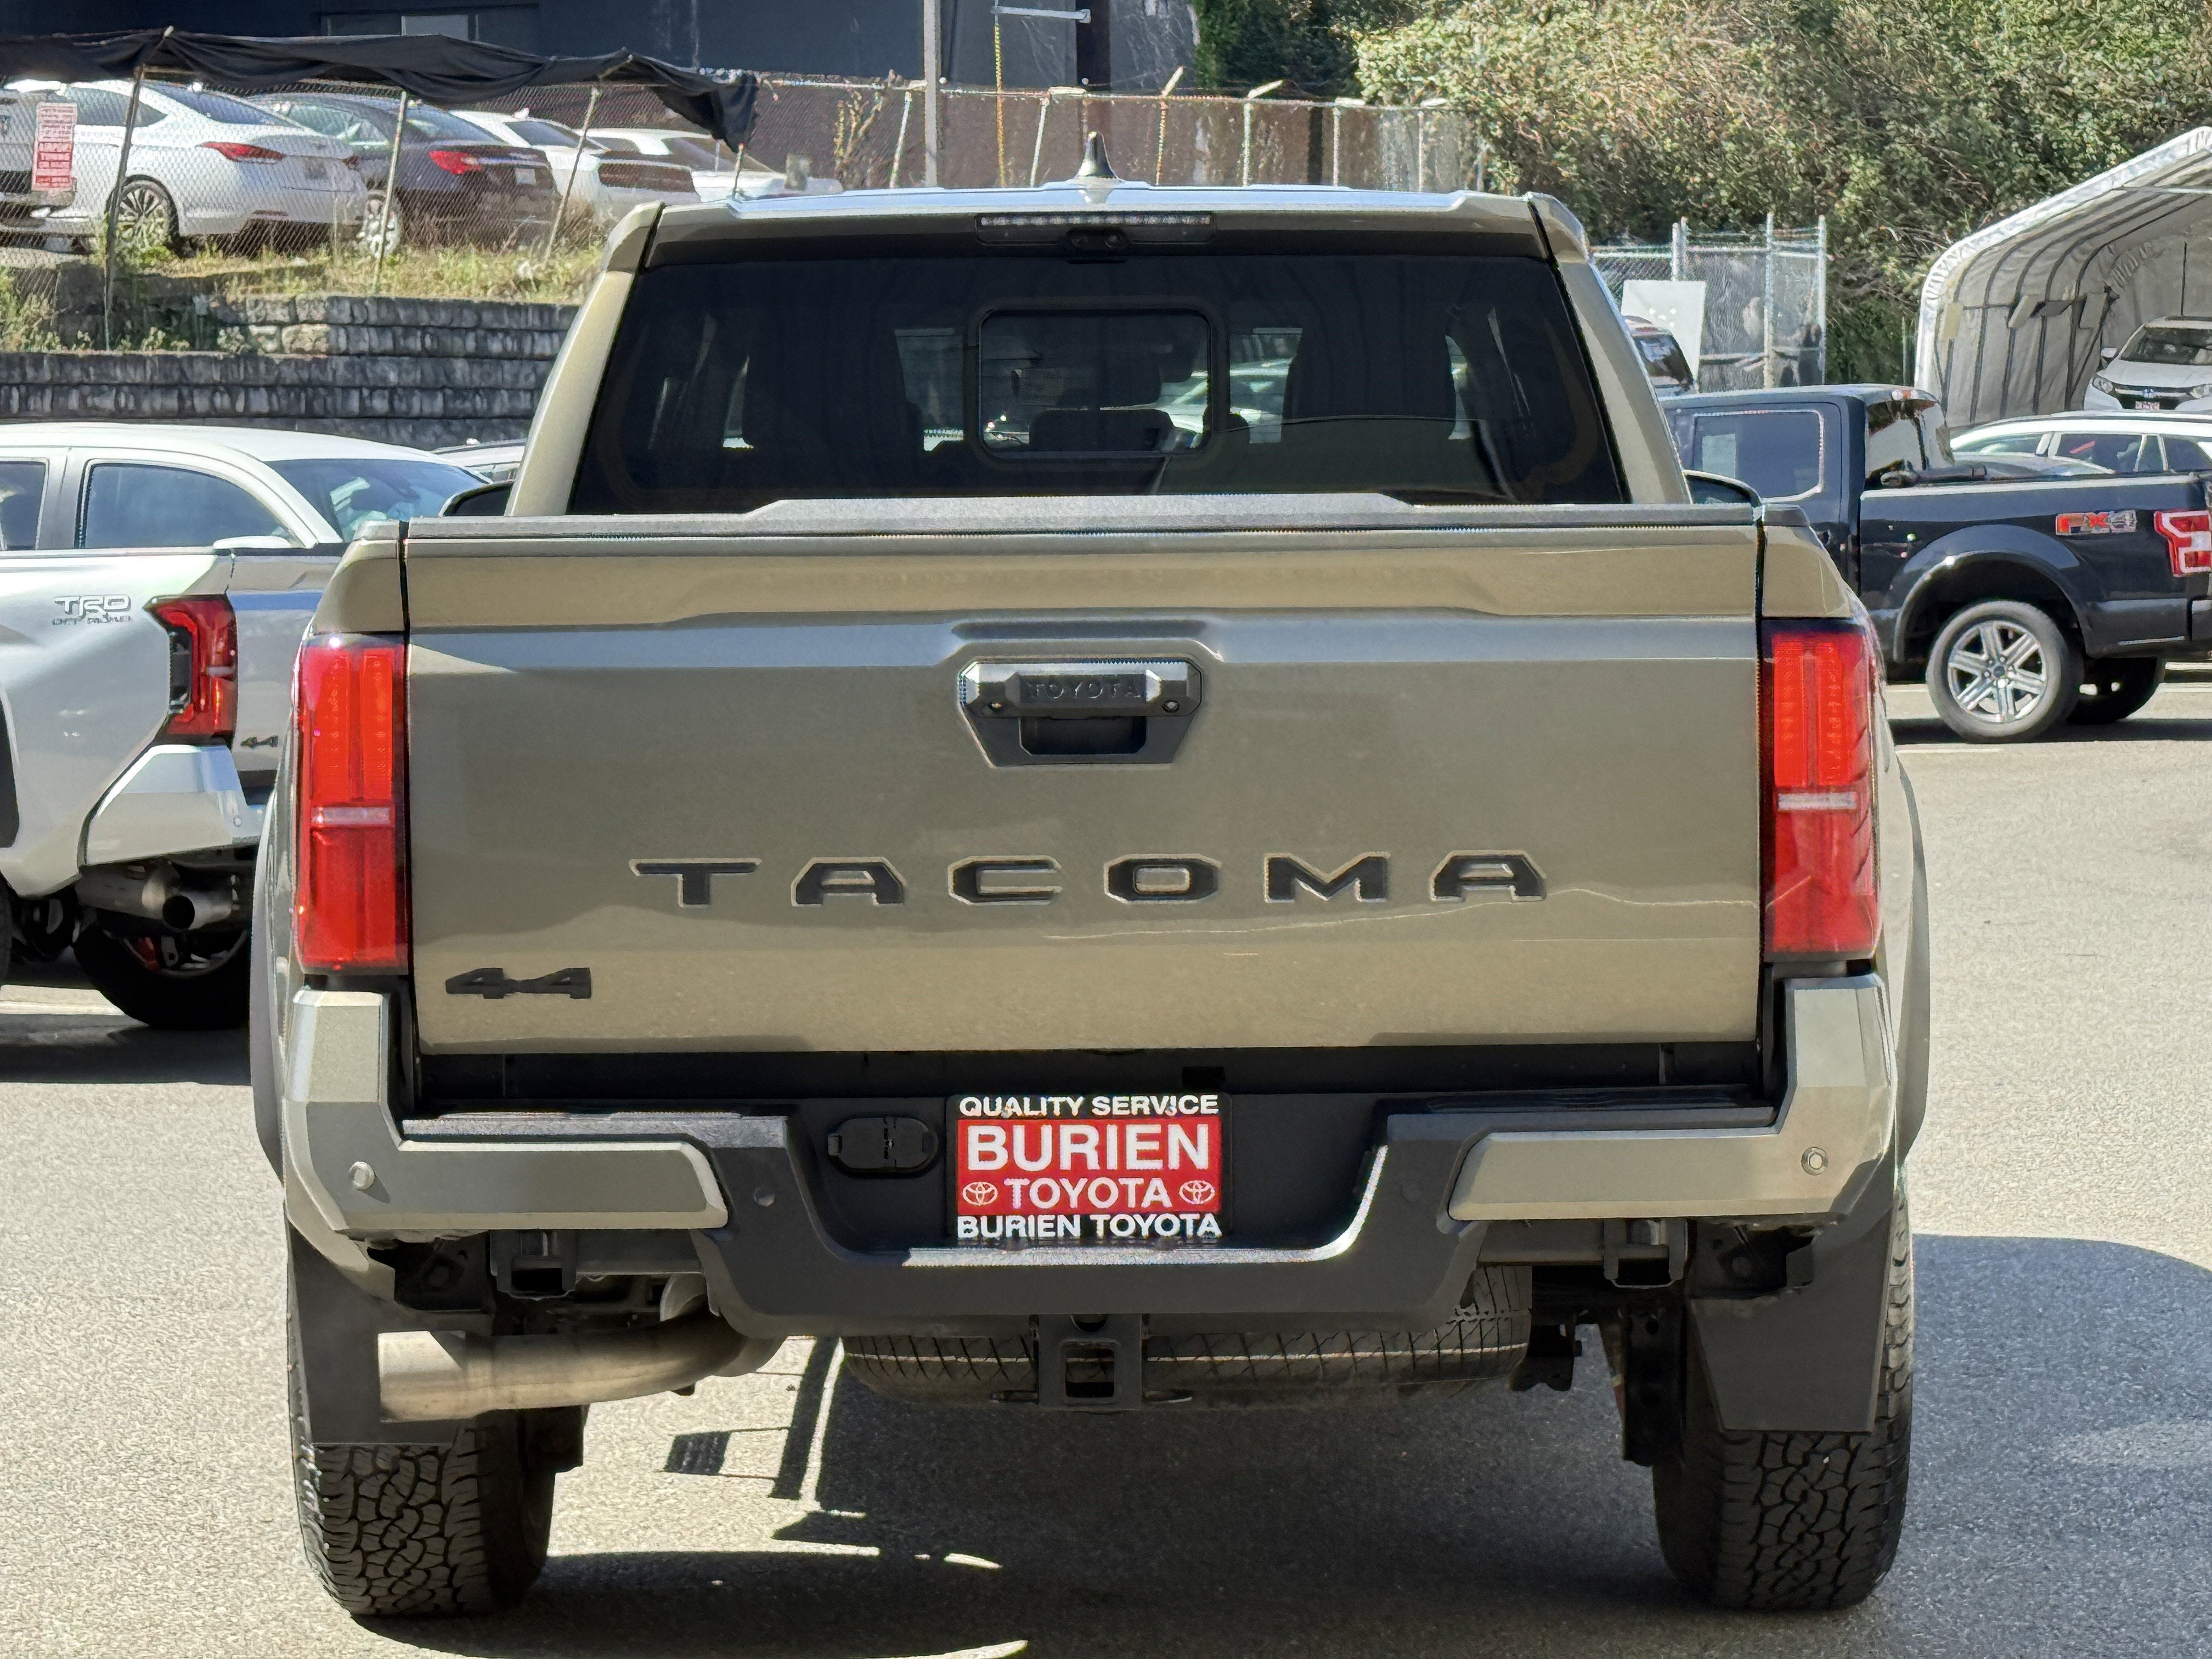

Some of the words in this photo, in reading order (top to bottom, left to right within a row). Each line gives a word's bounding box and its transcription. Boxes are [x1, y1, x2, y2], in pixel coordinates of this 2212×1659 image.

[54, 595, 131, 619] TRD
[1027, 681, 1142, 699] TOYOTA
[629, 850, 1547, 906] TACOMA
[959, 1096, 1084, 1117] QUALITY
[1091, 1094, 1219, 1116] SERVICE
[967, 1124, 1209, 1171] BURIEN
[1003, 1177, 1173, 1209] TOYOTA
[957, 1215, 1081, 1238] BURIEN
[1090, 1213, 1223, 1237] TOYOTA
